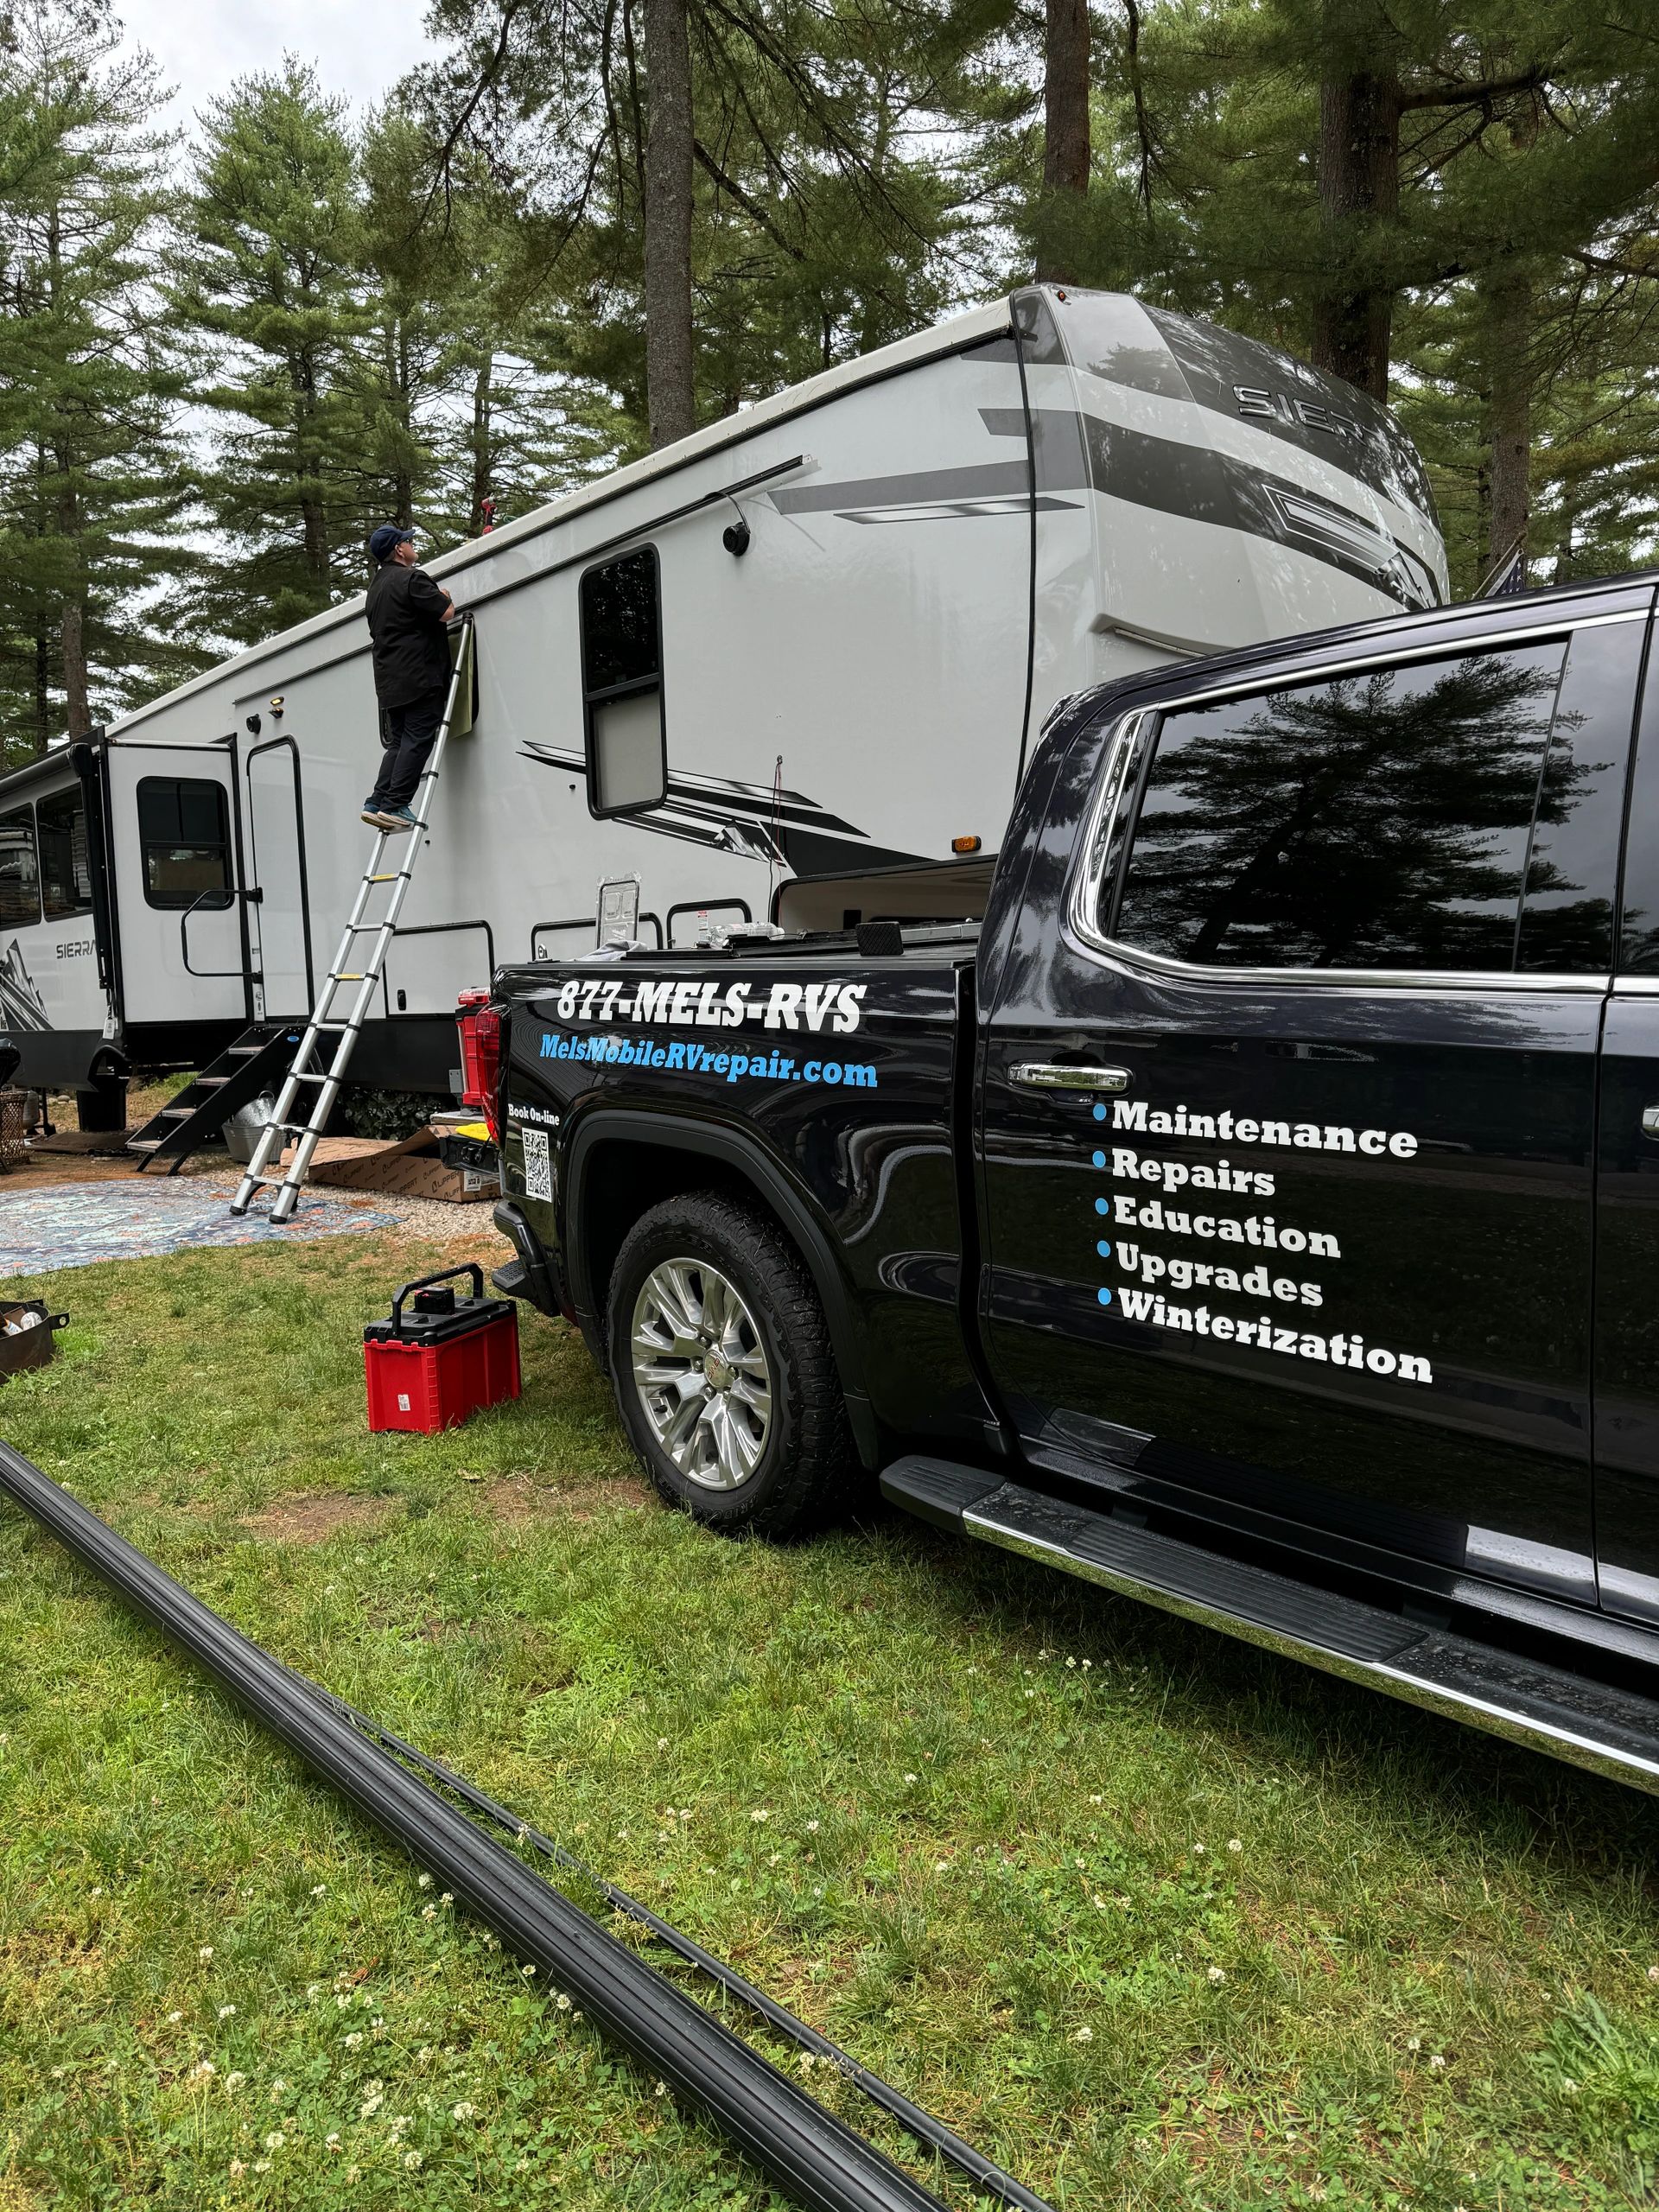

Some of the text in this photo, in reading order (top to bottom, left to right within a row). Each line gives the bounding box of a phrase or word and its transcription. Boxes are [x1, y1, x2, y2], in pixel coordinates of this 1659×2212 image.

[557, 981, 868, 1033] 877-MELS-RVS
[540, 1034, 878, 1088] MelsMobileRVrepair.com
[507, 1103, 530, 1120] Book
[530, 1107, 560, 1126] On-line
[1112, 1100, 1418, 1158] Maintenance
[1112, 1147, 1275, 1197] Repairs
[1113, 1195, 1341, 1259] Education
[1116, 1241, 1324, 1306] Upgrades
[1117, 1287, 1433, 1384] Winterization
